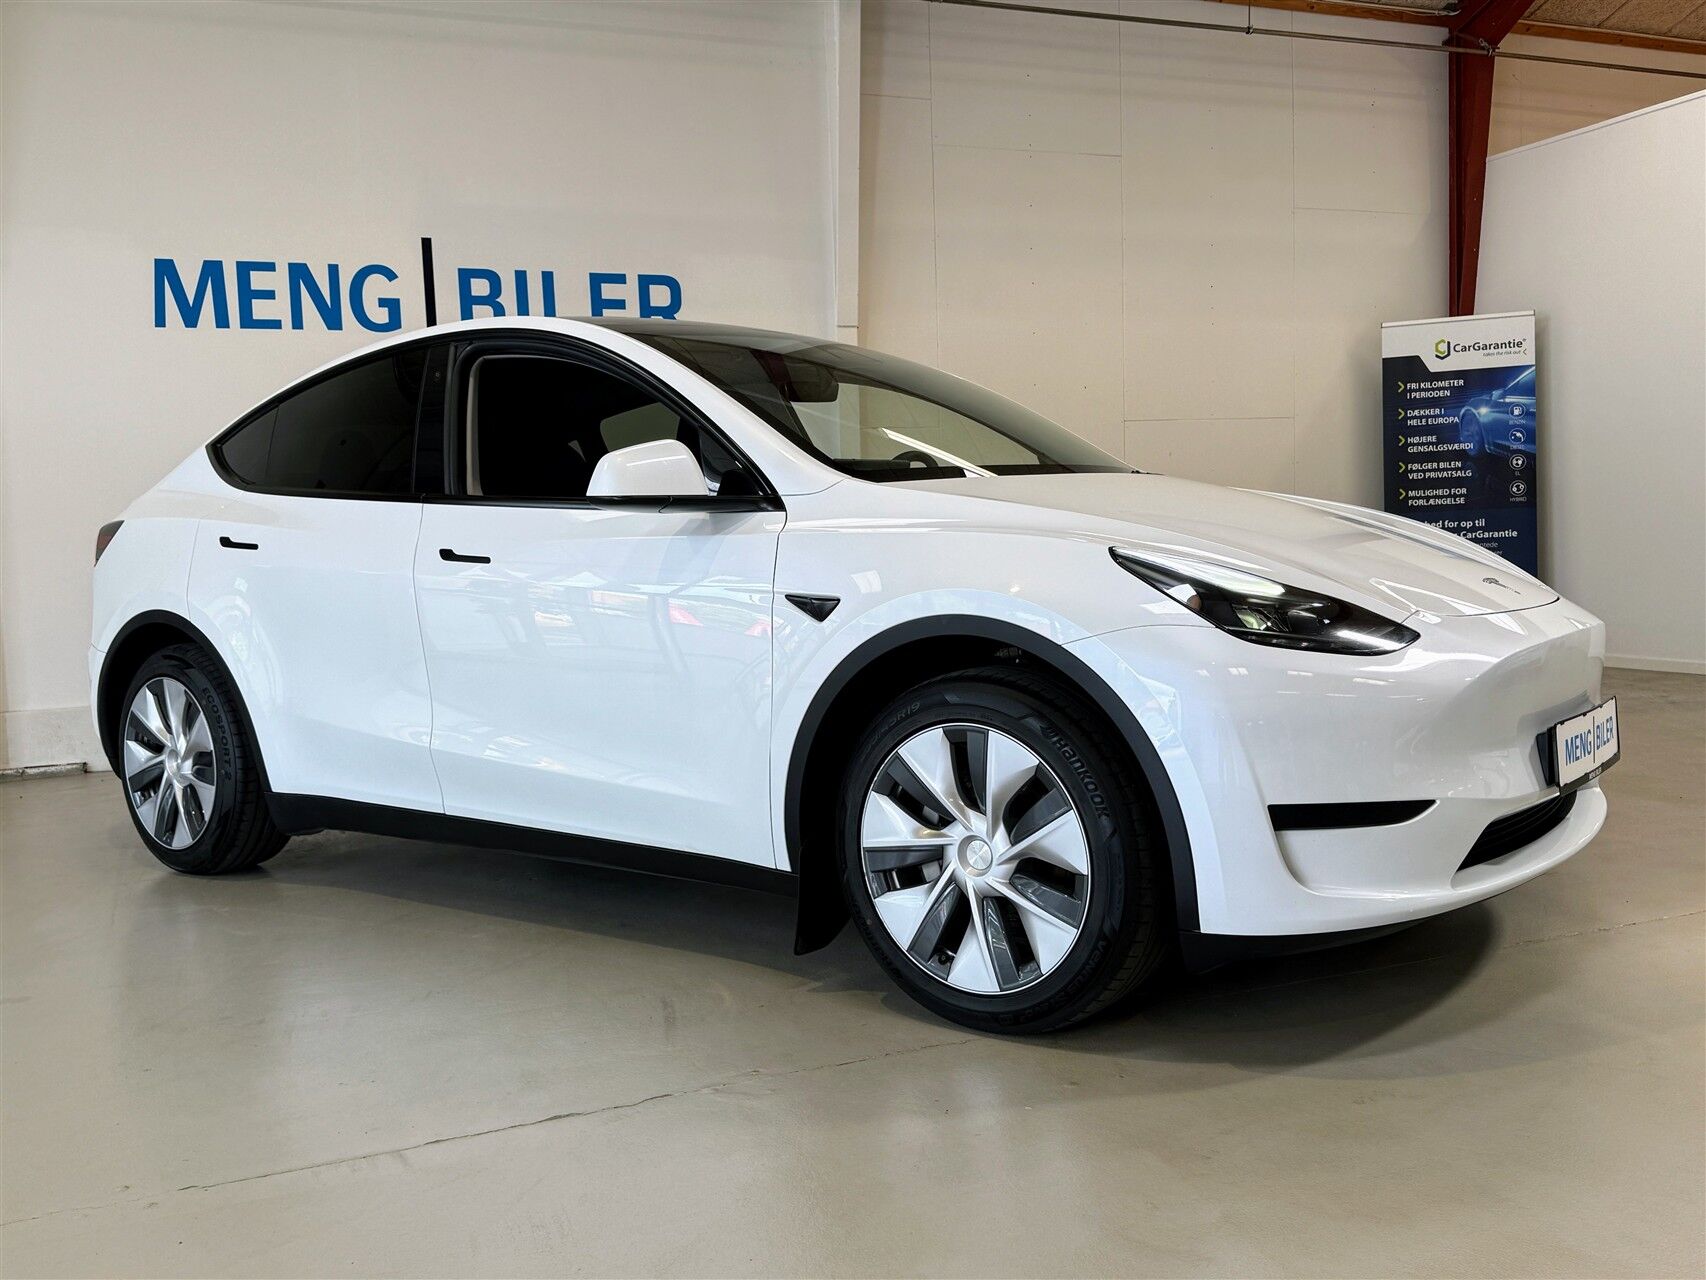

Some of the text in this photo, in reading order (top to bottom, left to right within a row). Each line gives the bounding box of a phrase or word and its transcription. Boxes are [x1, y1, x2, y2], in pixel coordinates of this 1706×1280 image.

[153, 258, 402, 332] MENG
[1420, 380, 1464, 389] KILOMETER
[1412, 390, 1450, 398] PERIODEN
[1408, 408, 1440, 416] DÆKKER
[1428, 416, 1460, 425] EUROPA
[1408, 436, 1437, 444] HØJERE
[1408, 443, 1473, 453] GENSALGSVÆRDI
[1408, 462, 1437, 470] FØLGER
[1426, 470, 1472, 478] PRIVATSALG
[1408, 489, 1449, 497] MULIGHED
[1408, 497, 1465, 506] FORLÆNGELSE
[1444, 520, 1458, 528] for
[1460, 521, 1473, 529] op
[1460, 529, 1518, 538] CarGarantie
[1565, 716, 1614, 766] MENG BILER
